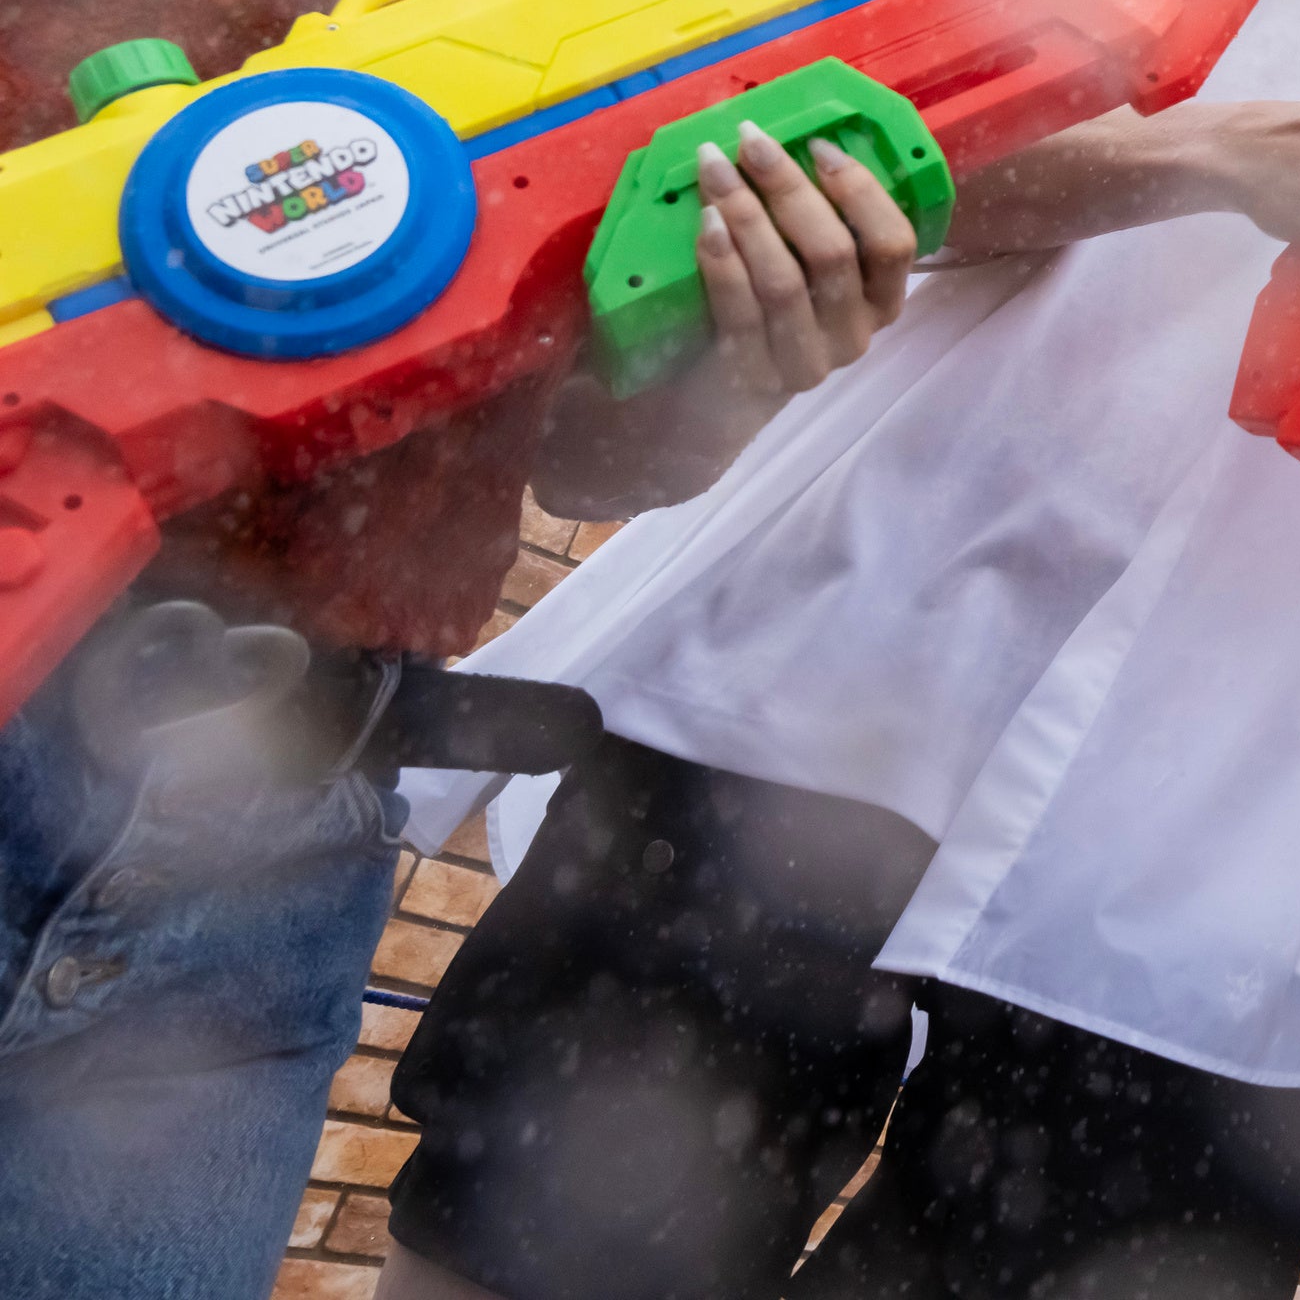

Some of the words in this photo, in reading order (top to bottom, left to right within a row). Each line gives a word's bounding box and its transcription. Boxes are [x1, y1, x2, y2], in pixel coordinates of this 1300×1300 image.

[207, 138, 377, 227] NINTENDO
[245, 140, 322, 183] SUPER
[248, 170, 365, 233] WORLD
